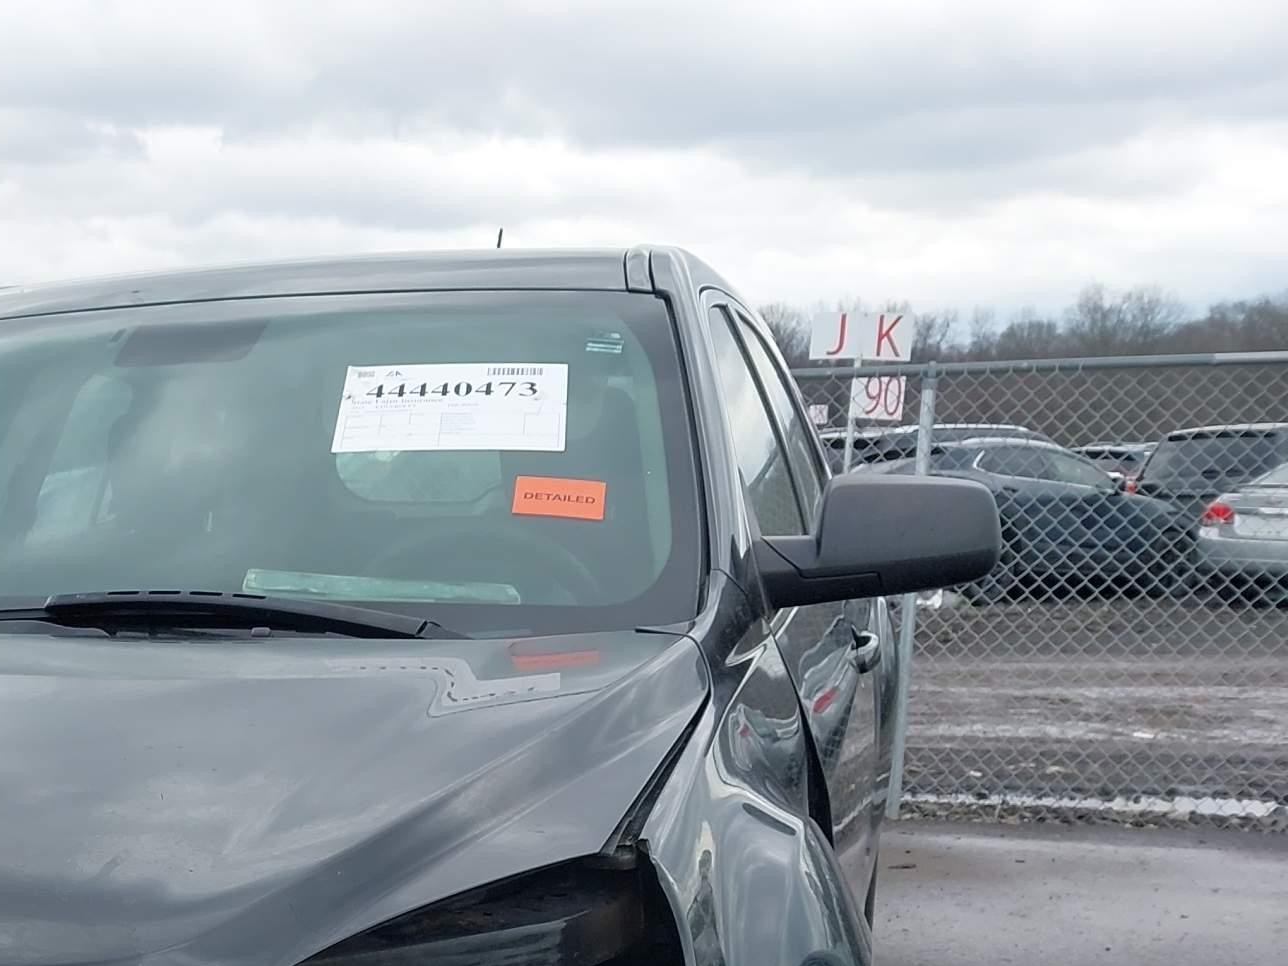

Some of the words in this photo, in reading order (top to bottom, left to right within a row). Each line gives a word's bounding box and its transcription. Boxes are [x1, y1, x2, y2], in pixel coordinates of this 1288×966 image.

[826, 312, 847, 356] J
[875, 314, 903, 357] K
[365, 380, 539, 399] 44440473
[864, 376, 902, 416] 90
[523, 491, 596, 505] DETAILED
